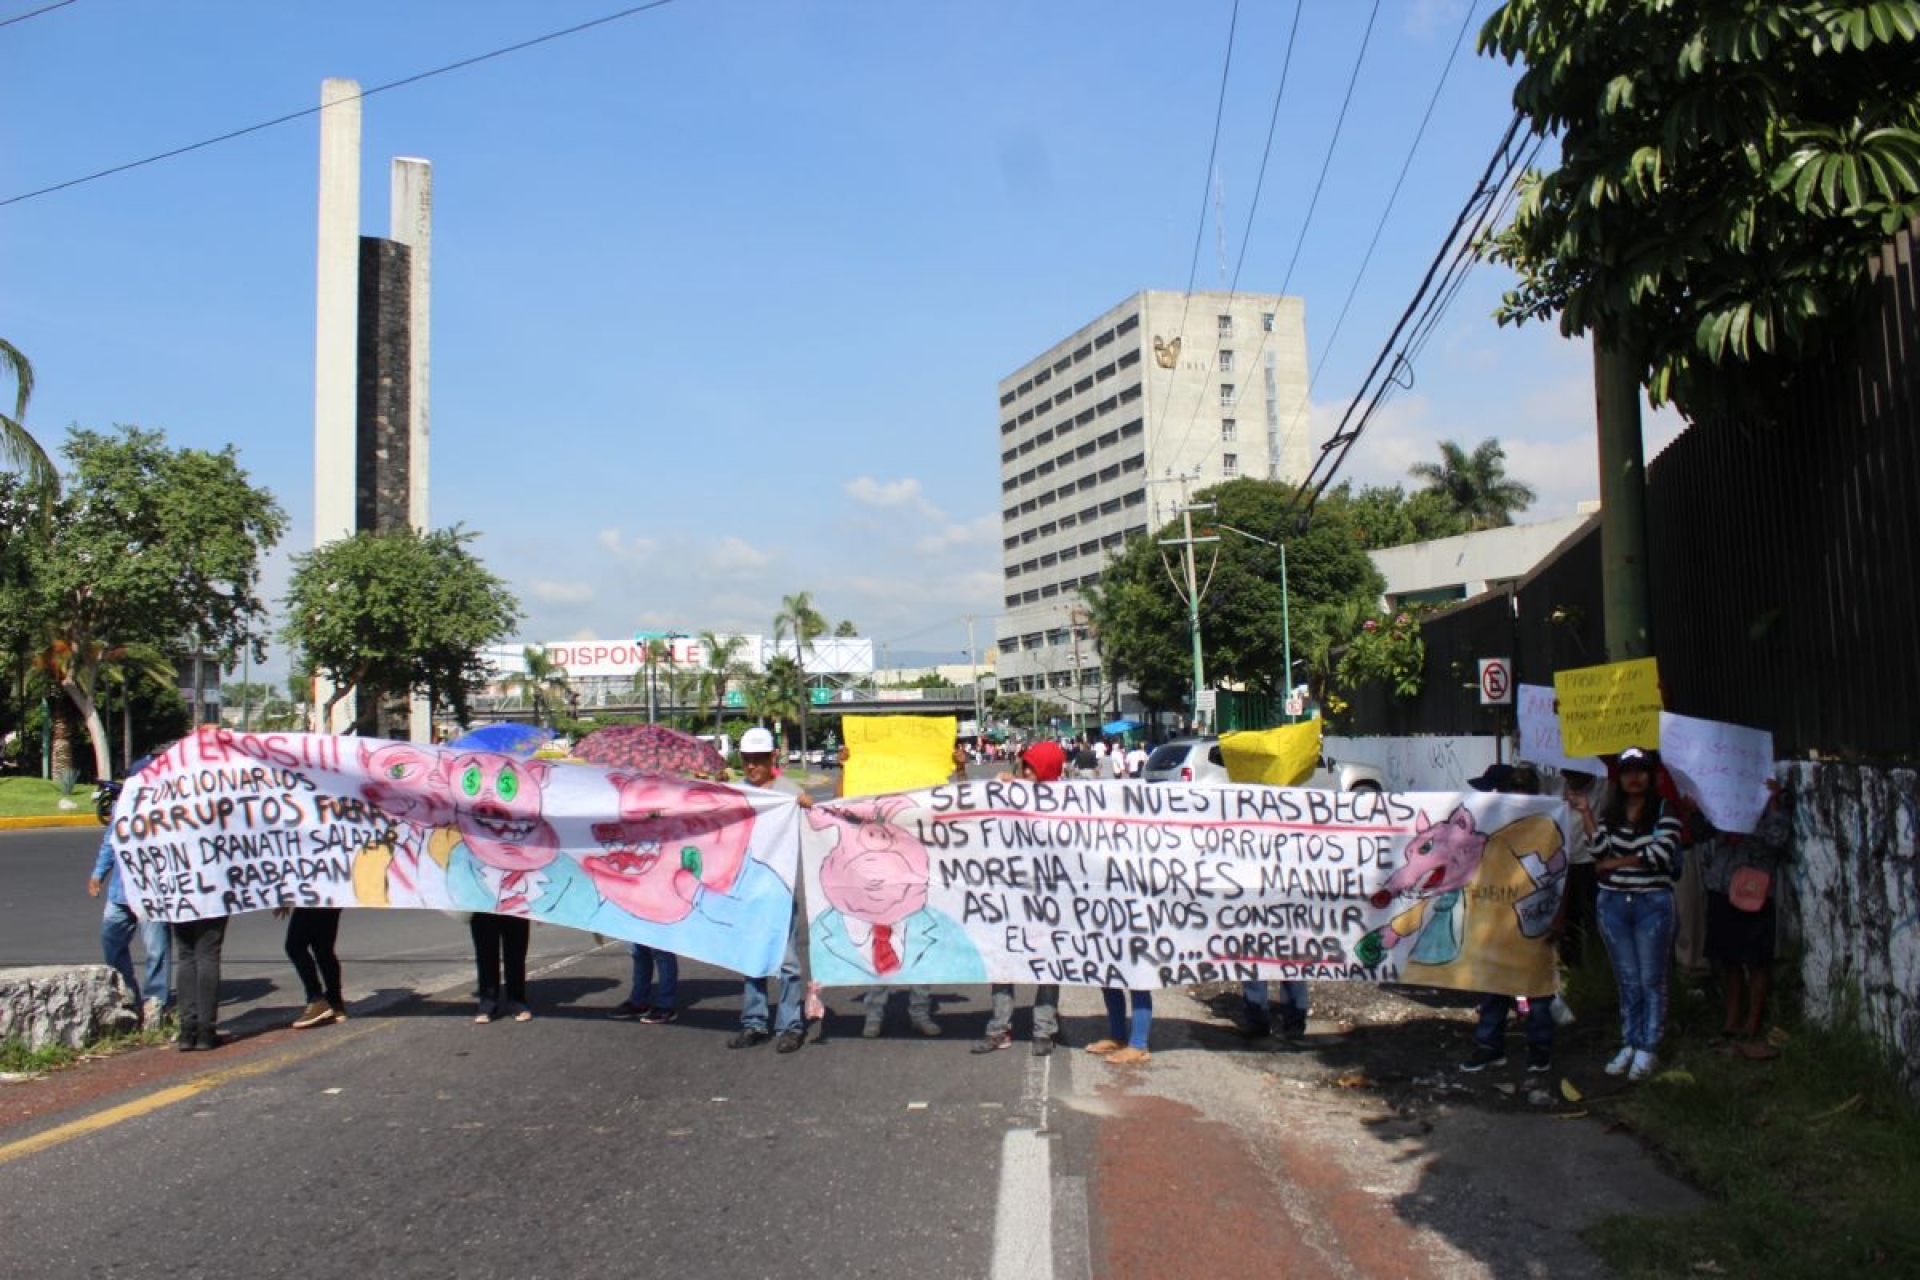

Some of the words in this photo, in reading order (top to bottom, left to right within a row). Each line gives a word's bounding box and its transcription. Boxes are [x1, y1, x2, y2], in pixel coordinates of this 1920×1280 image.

[554, 645, 701, 667] DISPONLE
[133, 767, 317, 813] FUNCIONARIOS
[931, 782, 975, 811] SE
[986, 781, 1107, 814] ROBAN
[1123, 785, 1301, 821] NUESTRAS
[1306, 790, 1415, 825] BECAS
[114, 793, 304, 843] CORRUPTOS
[120, 842, 191, 876] RABIN
[201, 829, 300, 866] DRANATH
[917, 818, 969, 849] LOS
[980, 818, 1182, 852] FUNCIONARIOS
[1191, 824, 1345, 863] CORRUPTOS
[1357, 835, 1395, 869] DE
[226, 855, 351, 890] RABADAN
[939, 852, 1090, 896] MORENA!
[1259, 864, 1372, 901] MANUEL
[1023, 894, 1061, 926] NO
[1073, 896, 1209, 936] PODEMOS
[1216, 902, 1368, 934] CONSTRUIR
[1005, 925, 1036, 953] EL
[1207, 932, 1346, 964] CORRELOS
[1028, 958, 1129, 988] FUERA
[1158, 962, 1259, 988] RABIN
[1280, 962, 1400, 982] DRANATH
